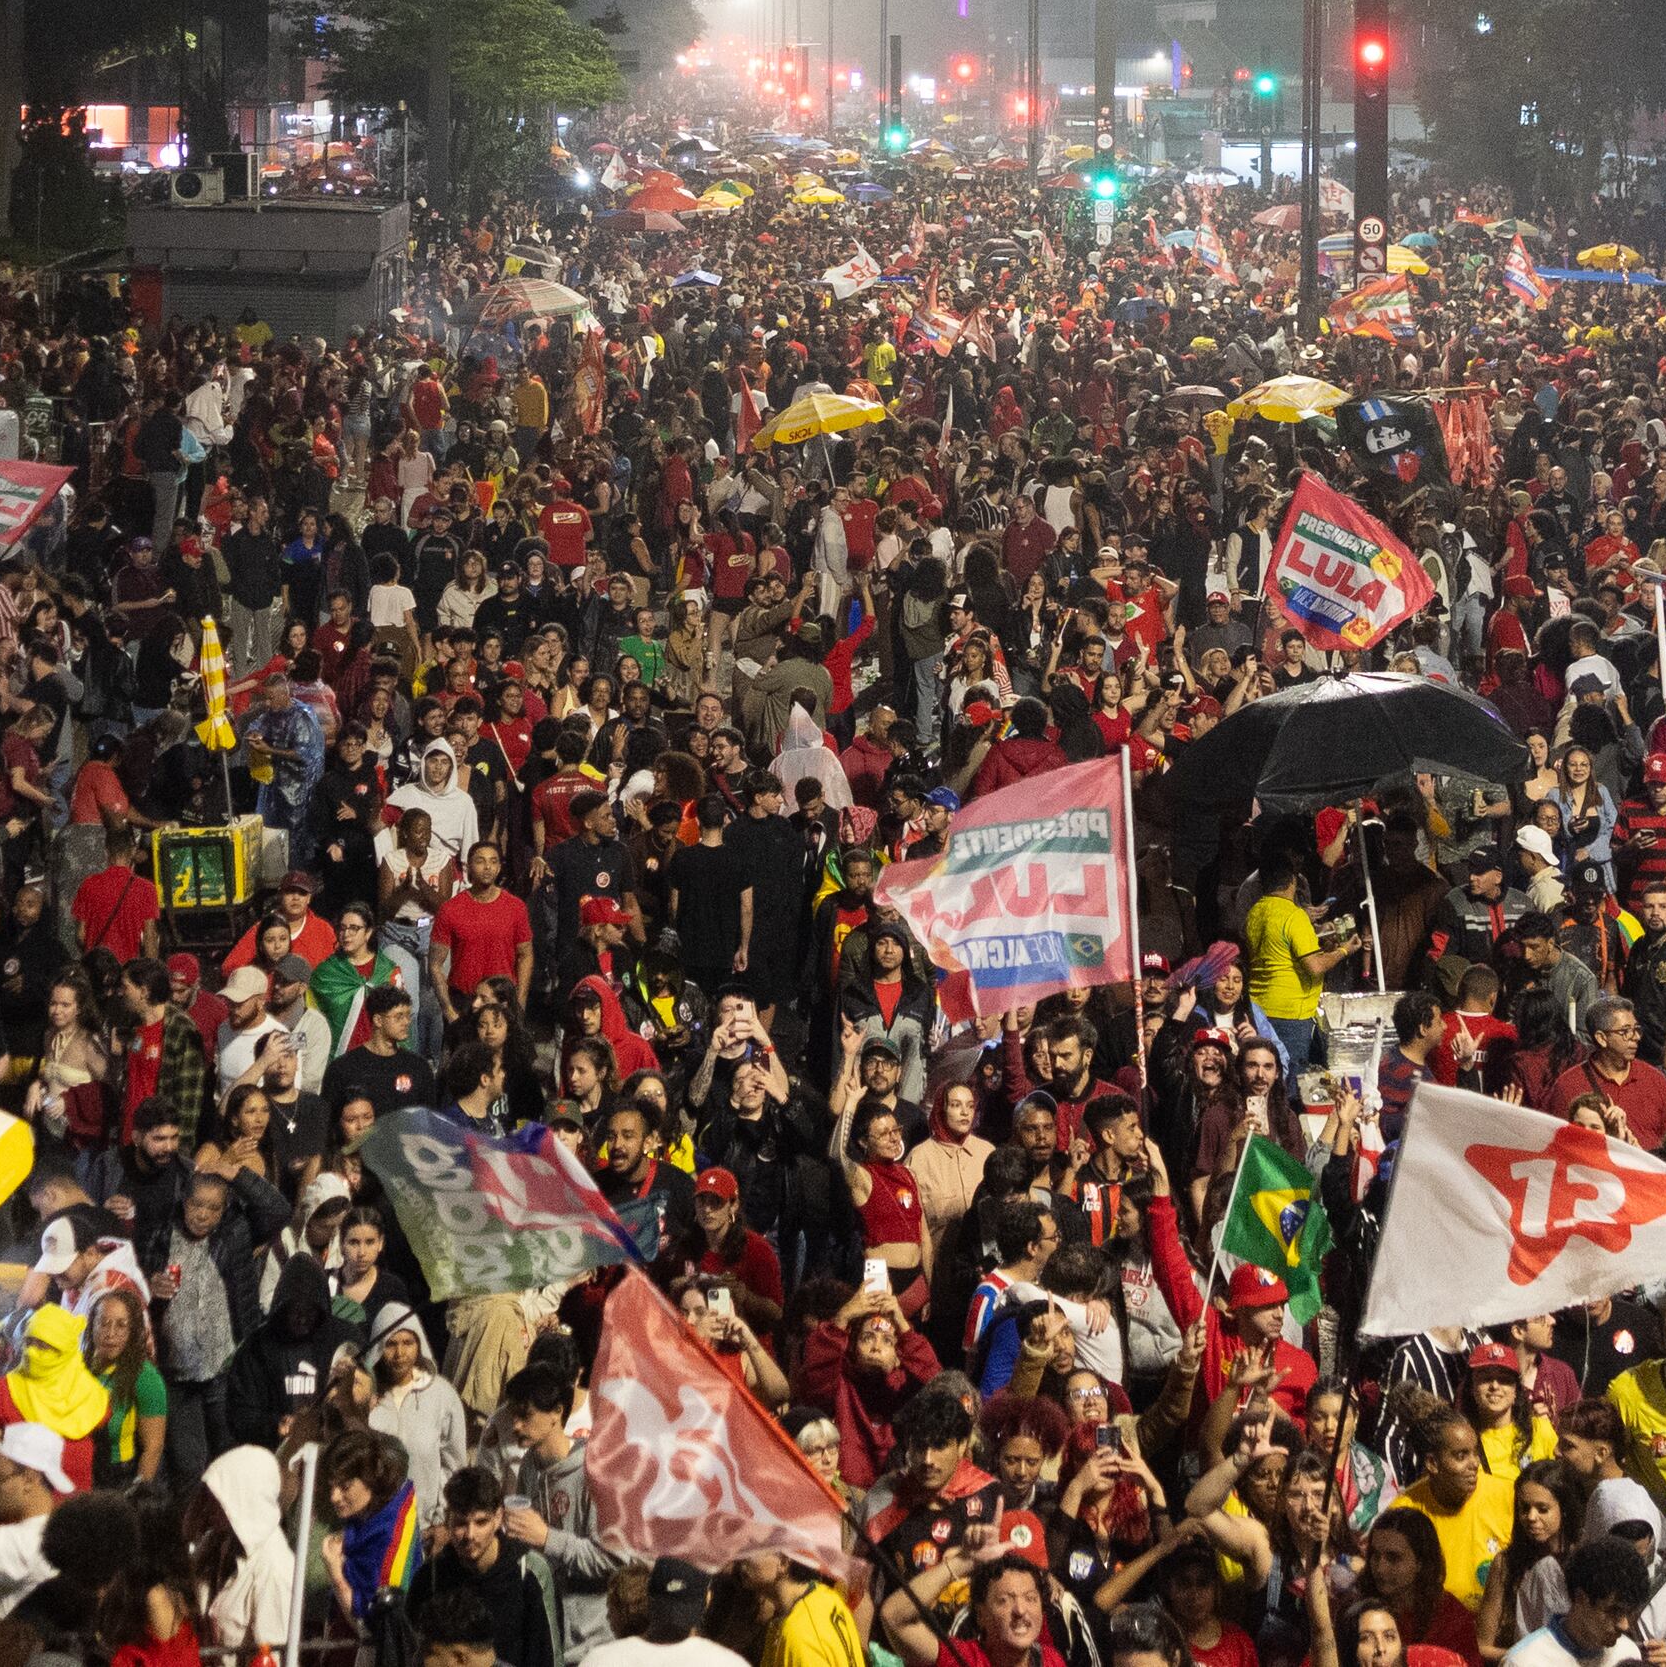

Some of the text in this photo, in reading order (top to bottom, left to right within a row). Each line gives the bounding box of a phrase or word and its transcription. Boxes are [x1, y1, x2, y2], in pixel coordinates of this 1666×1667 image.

[1363, 223, 1381, 235] 50
[788, 427, 813, 441] SKOL
[1296, 511, 1381, 558] PRESIDENTE
[1285, 539, 1388, 613] LULA
[1510, 1139, 1626, 1238] 13
